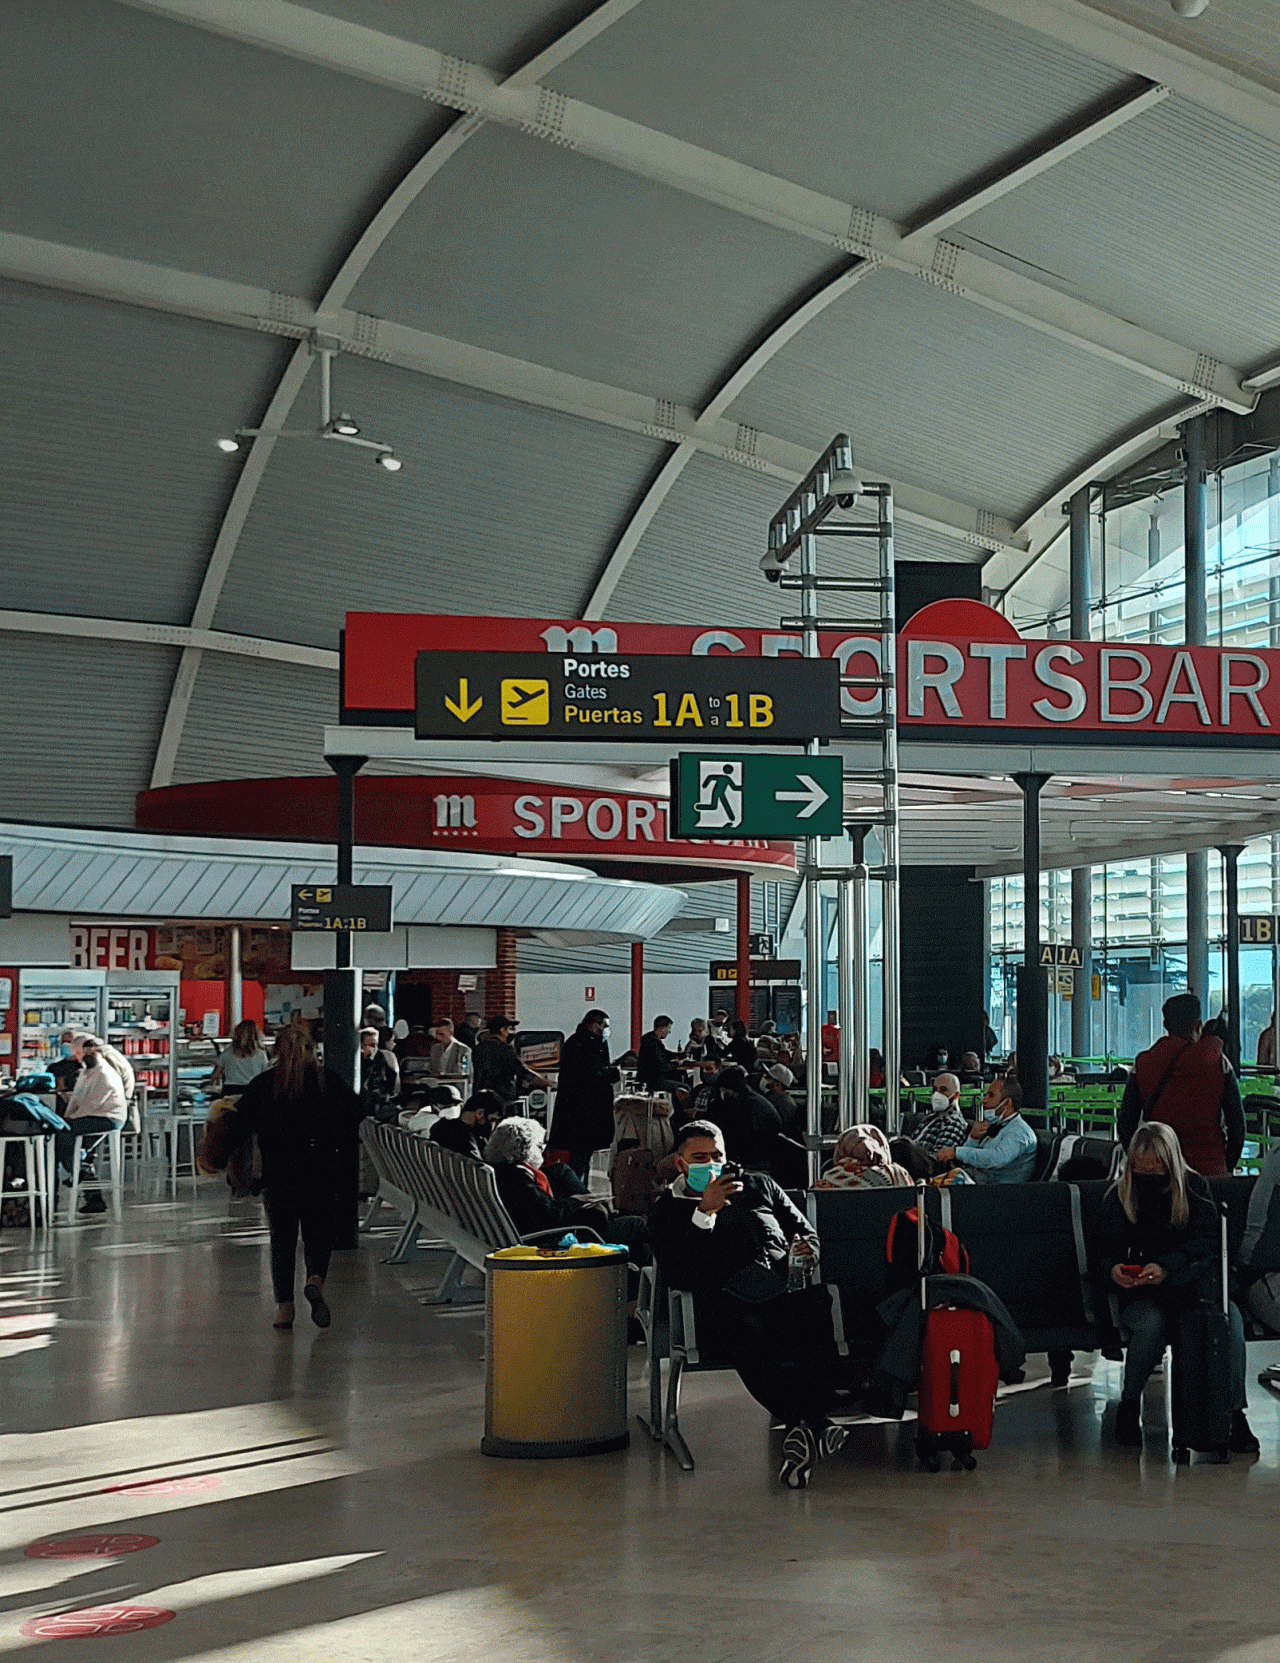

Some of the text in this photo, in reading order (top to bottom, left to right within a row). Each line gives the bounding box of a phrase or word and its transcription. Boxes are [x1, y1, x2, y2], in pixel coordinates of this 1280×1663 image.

[563, 658, 631, 679] Portes
[691, 631, 1271, 727] ORTSBAR
[564, 683, 608, 700] Gates
[564, 705, 643, 724] Puertas
[653, 693, 774, 728] 1A to 1B
[710, 714, 720, 726] a
[1242, 918, 1272, 941] 1B
[71, 928, 149, 971] BEER
[1041, 946, 1053, 963] A
[1059, 947, 1080, 965] 1A
